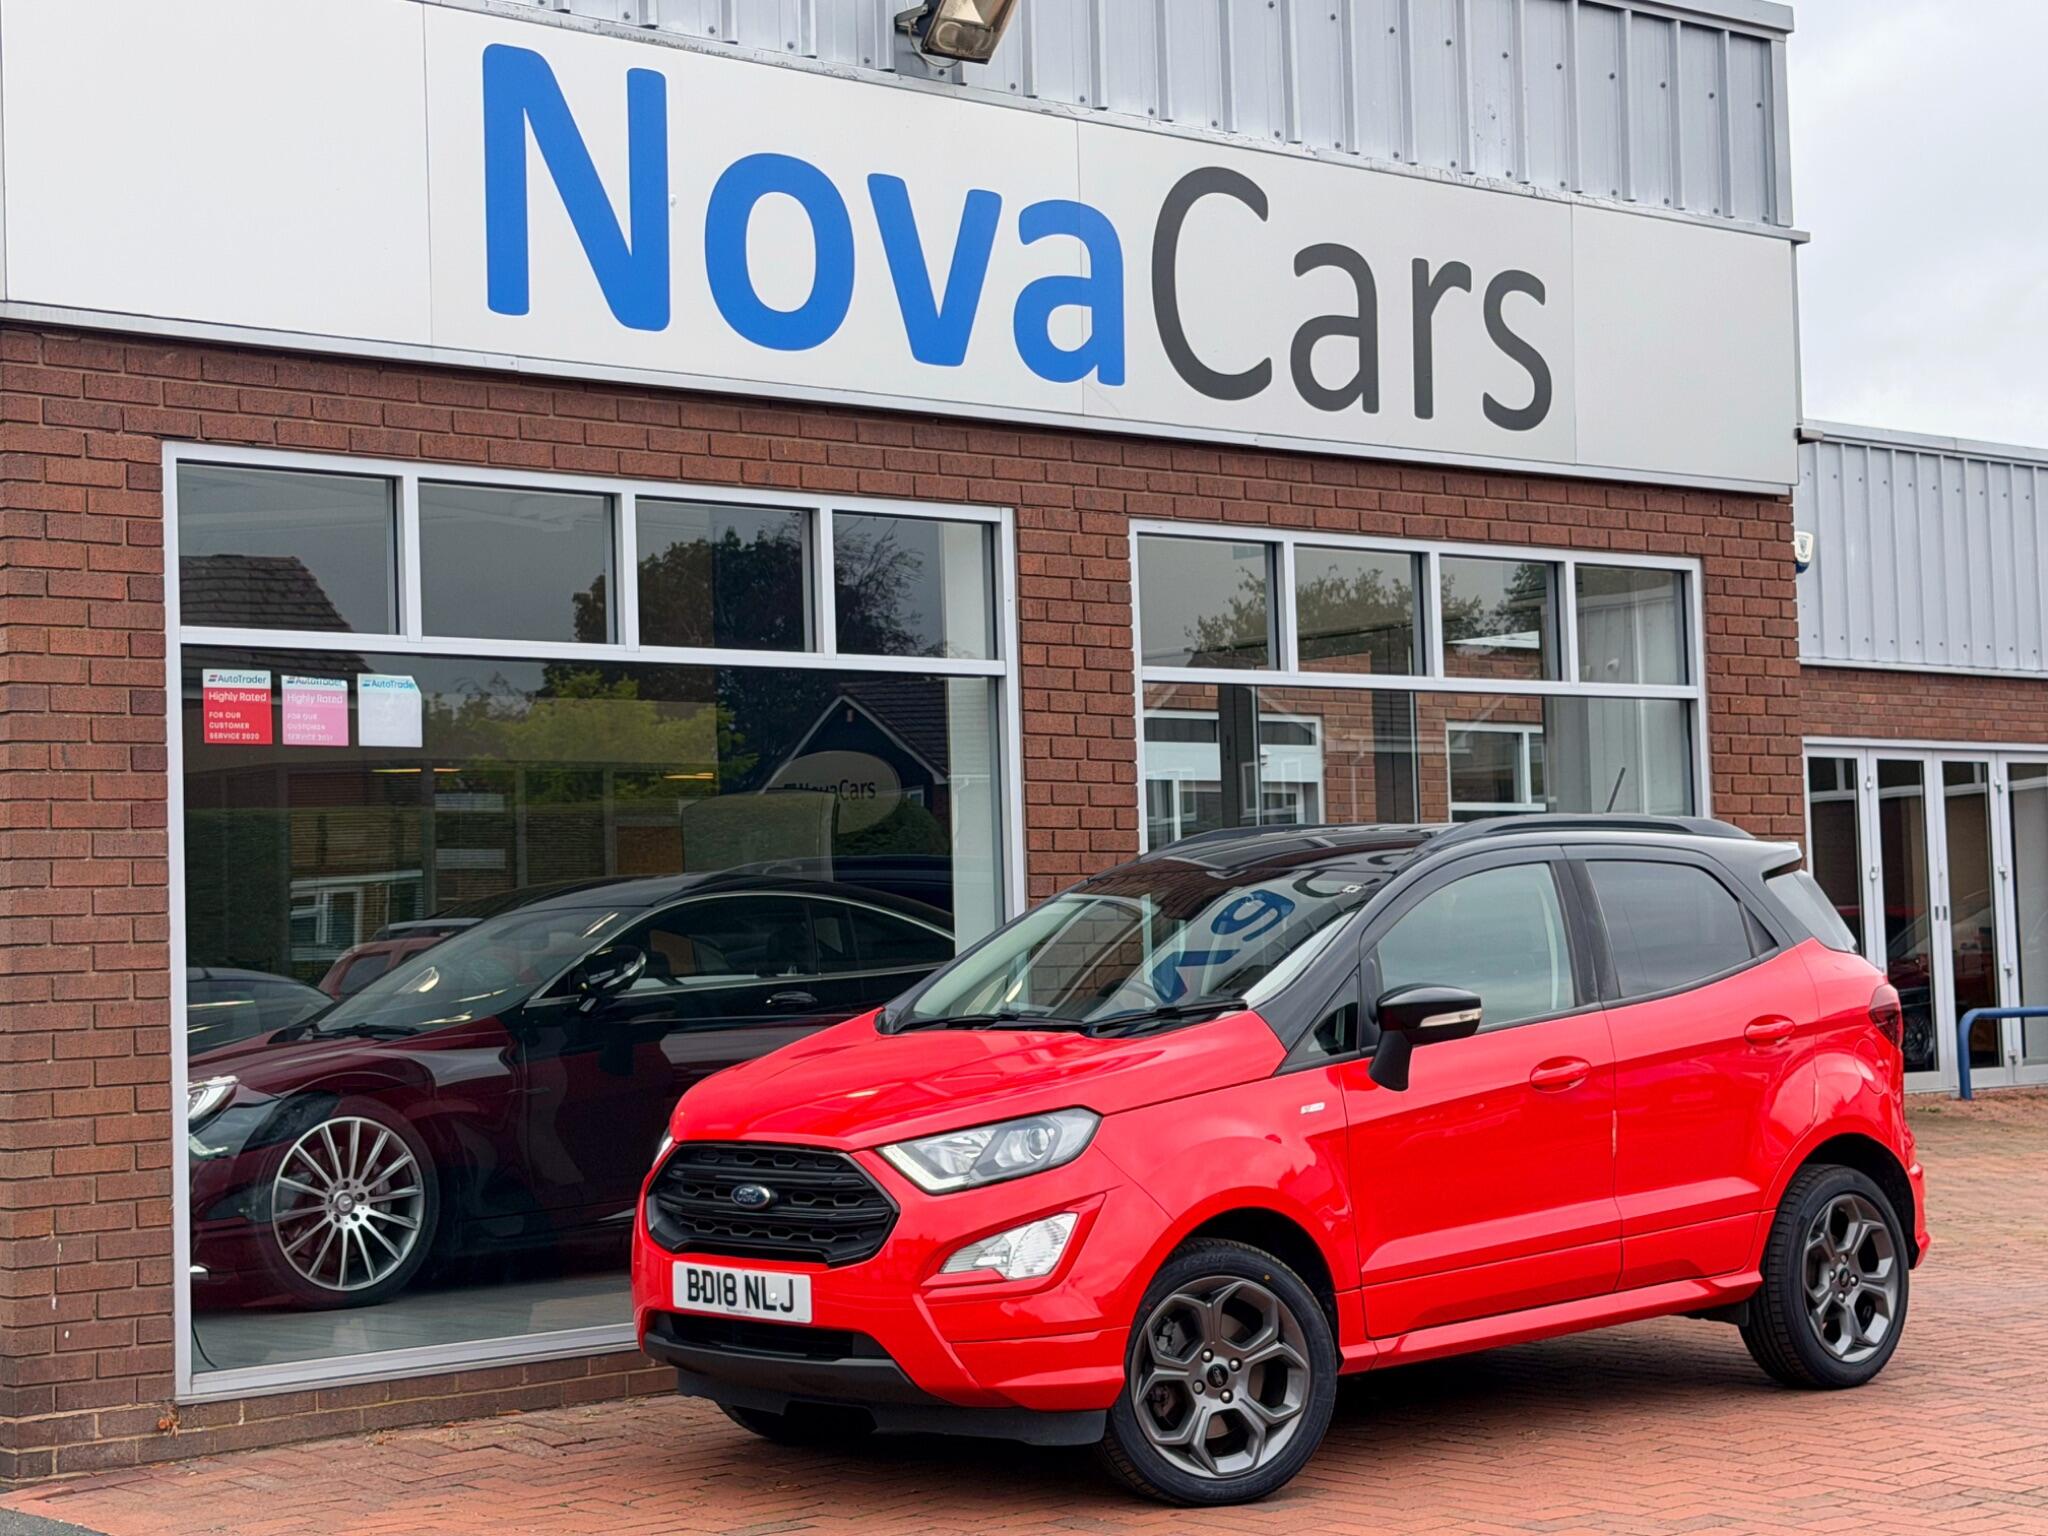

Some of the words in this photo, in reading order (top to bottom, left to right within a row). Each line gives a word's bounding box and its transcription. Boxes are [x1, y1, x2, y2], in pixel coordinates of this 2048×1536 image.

[482, 42, 1552, 431] NovaCars
[217, 674, 267, 685] AutoTrader
[208, 691, 238, 703] Highly
[239, 693, 267, 702] Rated
[287, 693, 316, 705] Highly
[208, 711, 224, 719] FOR
[687, 1268, 737, 1306] BD18
[744, 1274, 794, 1312] NLJ
